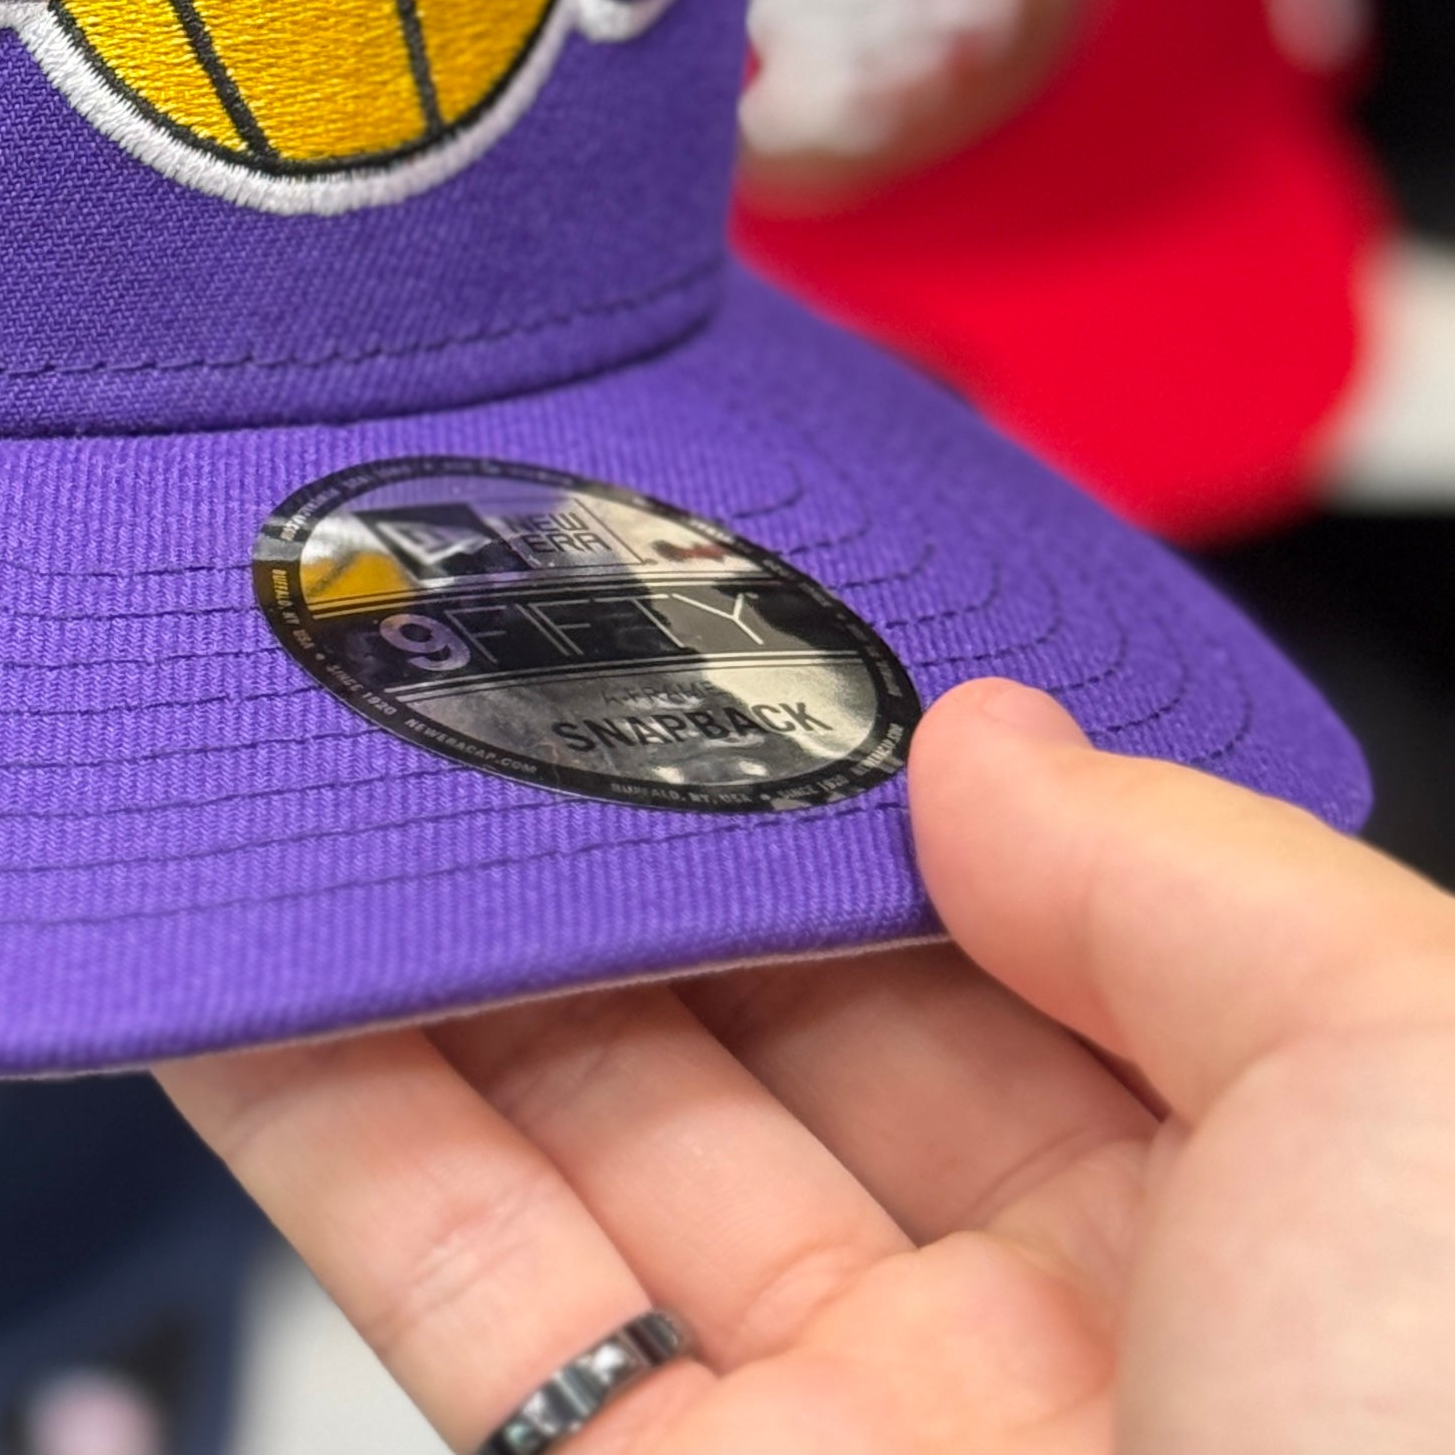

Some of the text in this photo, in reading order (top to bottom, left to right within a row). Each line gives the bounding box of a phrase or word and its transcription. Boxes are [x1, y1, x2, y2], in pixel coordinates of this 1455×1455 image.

[502, 511, 590, 533] NEW
[520, 531, 613, 554] ERA
[379, 592, 764, 672] 9FIFTY
[551, 701, 835, 753] SNAPBACK
